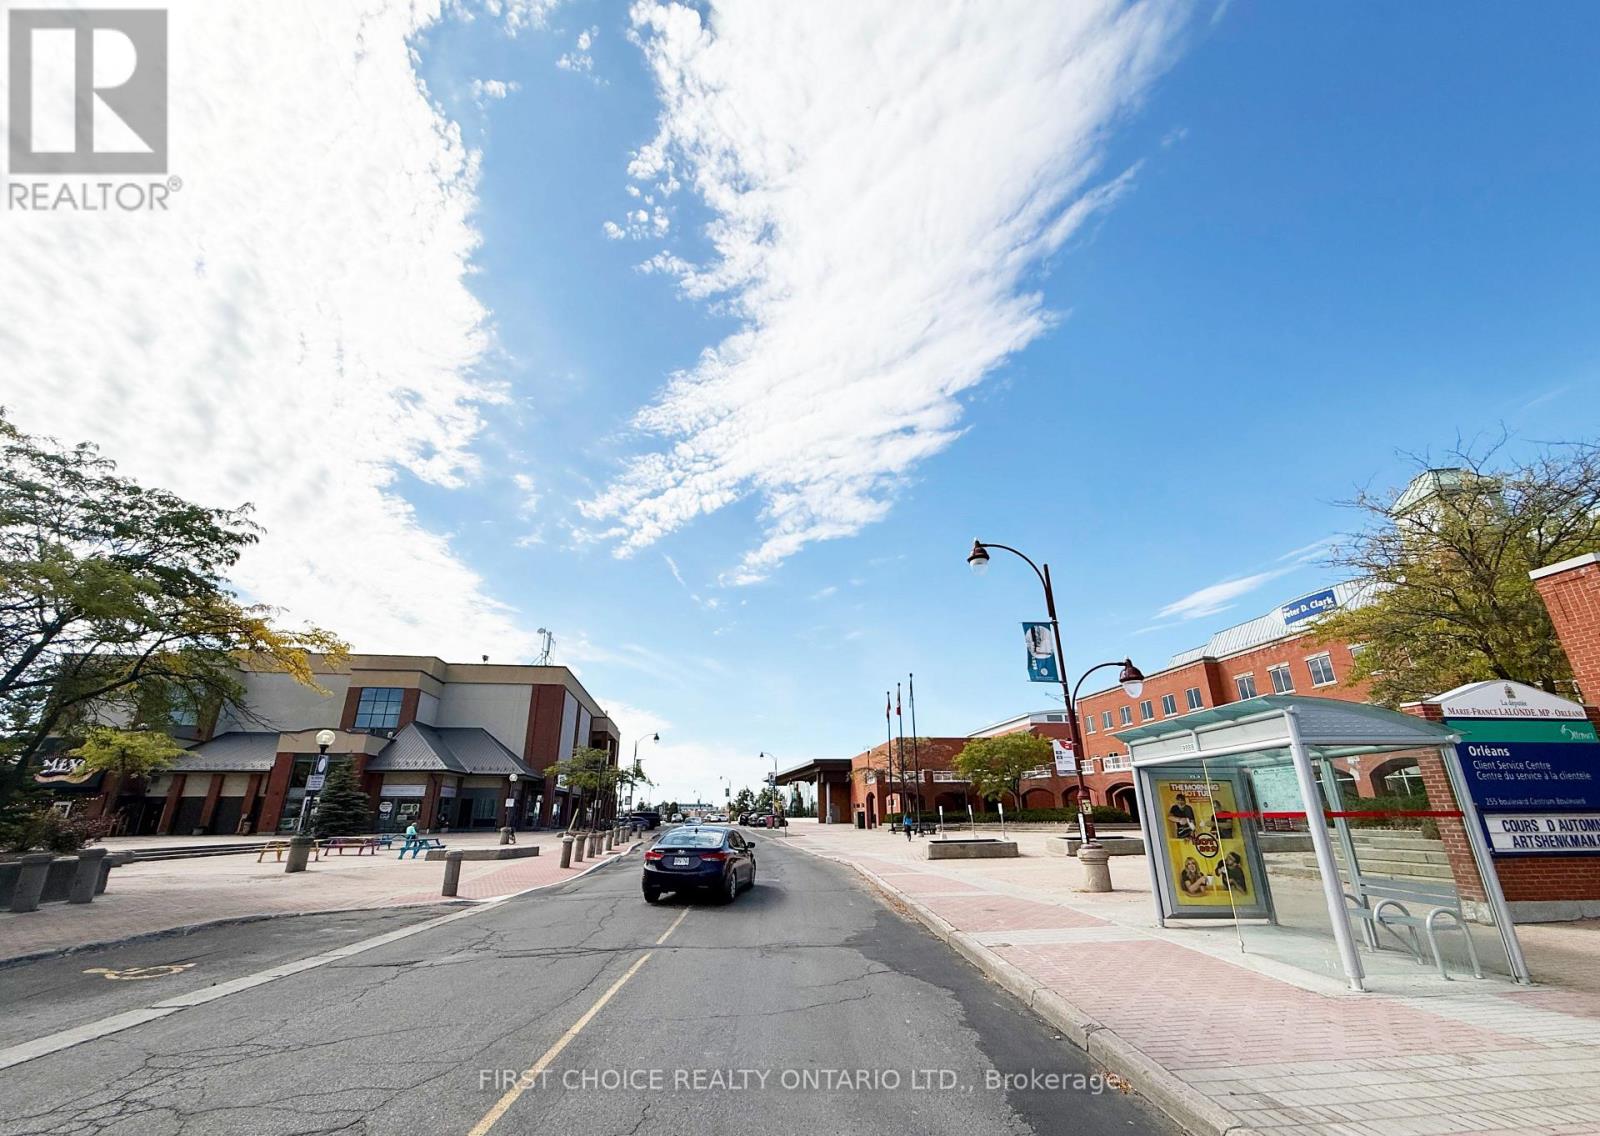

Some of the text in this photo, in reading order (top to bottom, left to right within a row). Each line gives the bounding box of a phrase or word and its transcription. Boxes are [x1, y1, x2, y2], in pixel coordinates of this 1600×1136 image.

[1310, 596, 1334, 610] Clark
[1540, 708, 1551, 717] MP
[1468, 745, 1511, 757] Orléans
[1472, 760, 1552, 770] Client Service Centre
[1476, 771, 1503, 780] Centre
[1503, 771, 1514, 780] du
[1516, 771, 1542, 780] service
[1549, 771, 1558, 780] la
[1502, 819, 1540, 833] COURS
[1546, 819, 1556, 832] D
